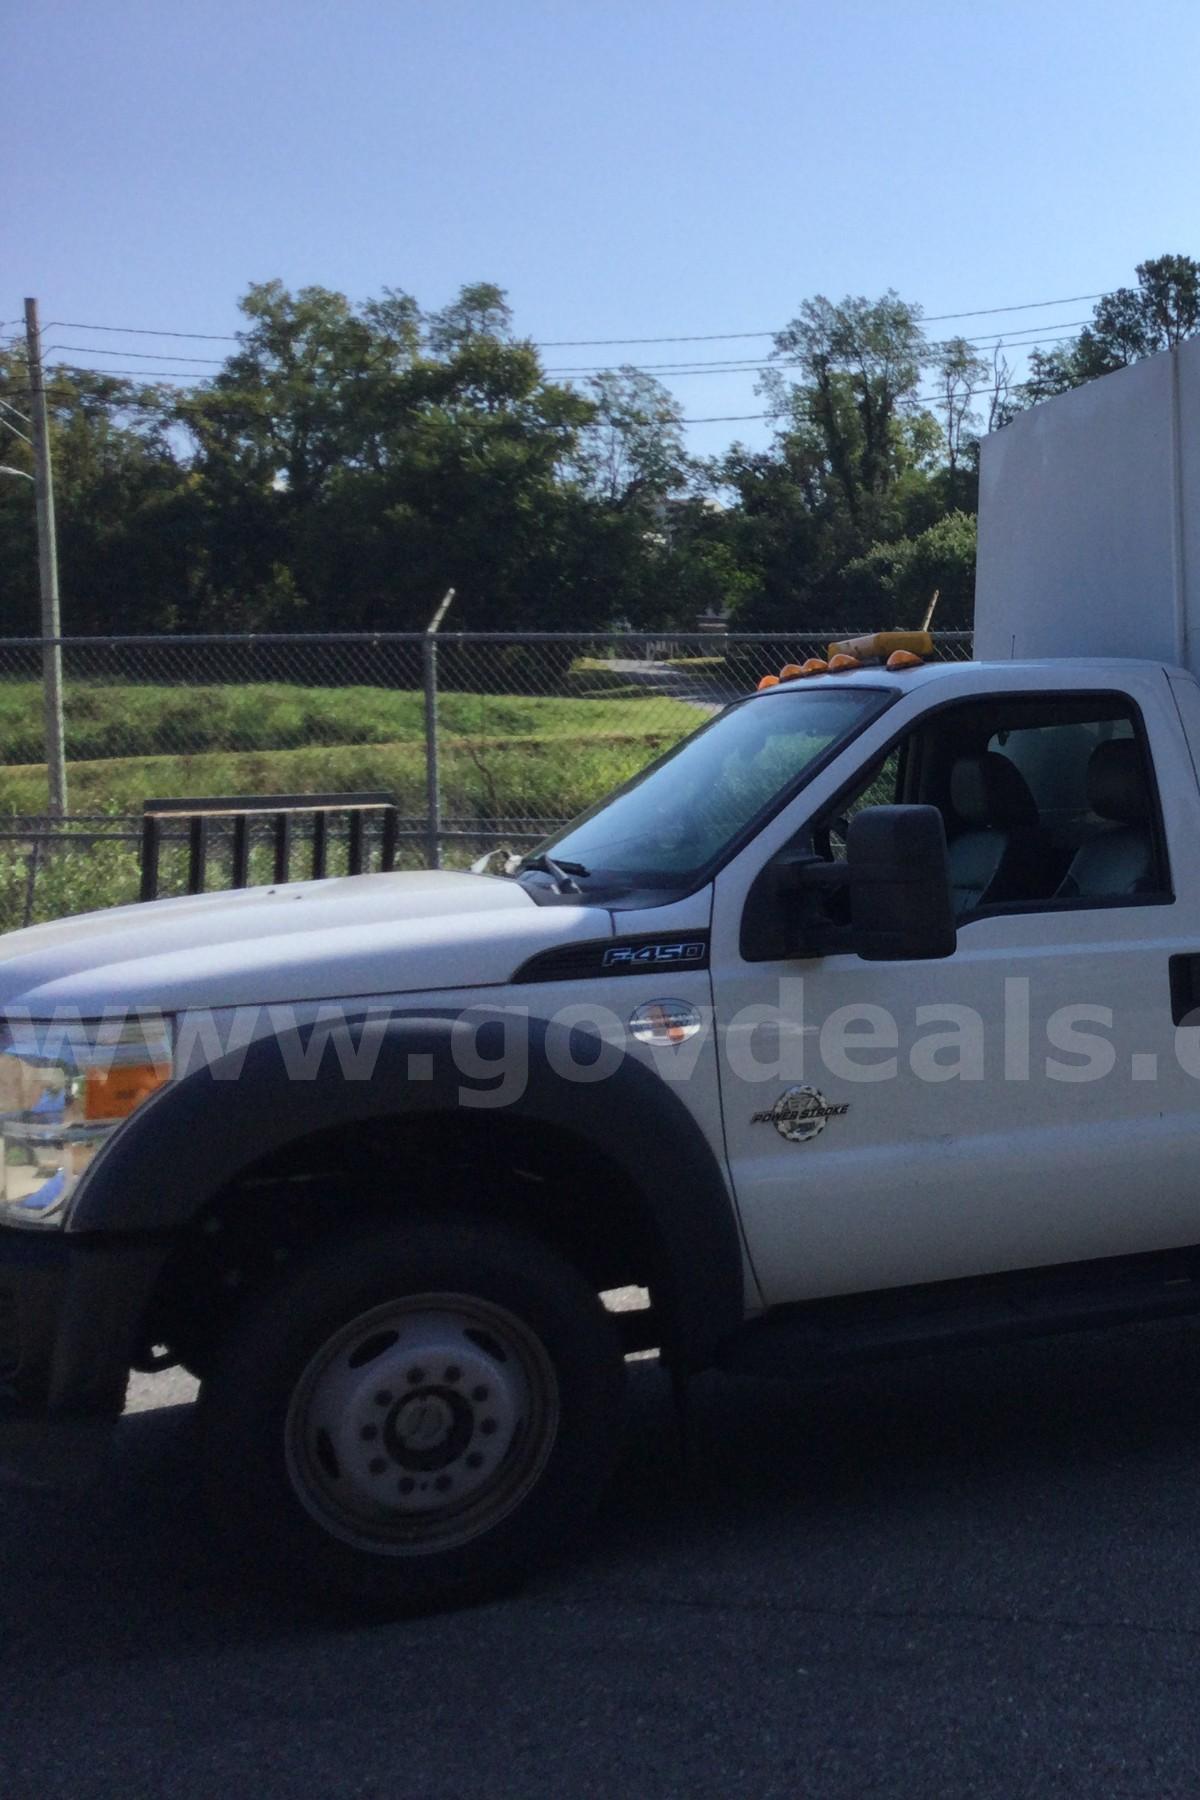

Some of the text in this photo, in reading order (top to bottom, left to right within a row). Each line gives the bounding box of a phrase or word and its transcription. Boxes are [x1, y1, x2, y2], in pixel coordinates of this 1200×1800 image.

[602, 943, 705, 967] F-450
[750, 1103, 850, 1124] POWER STROKE
